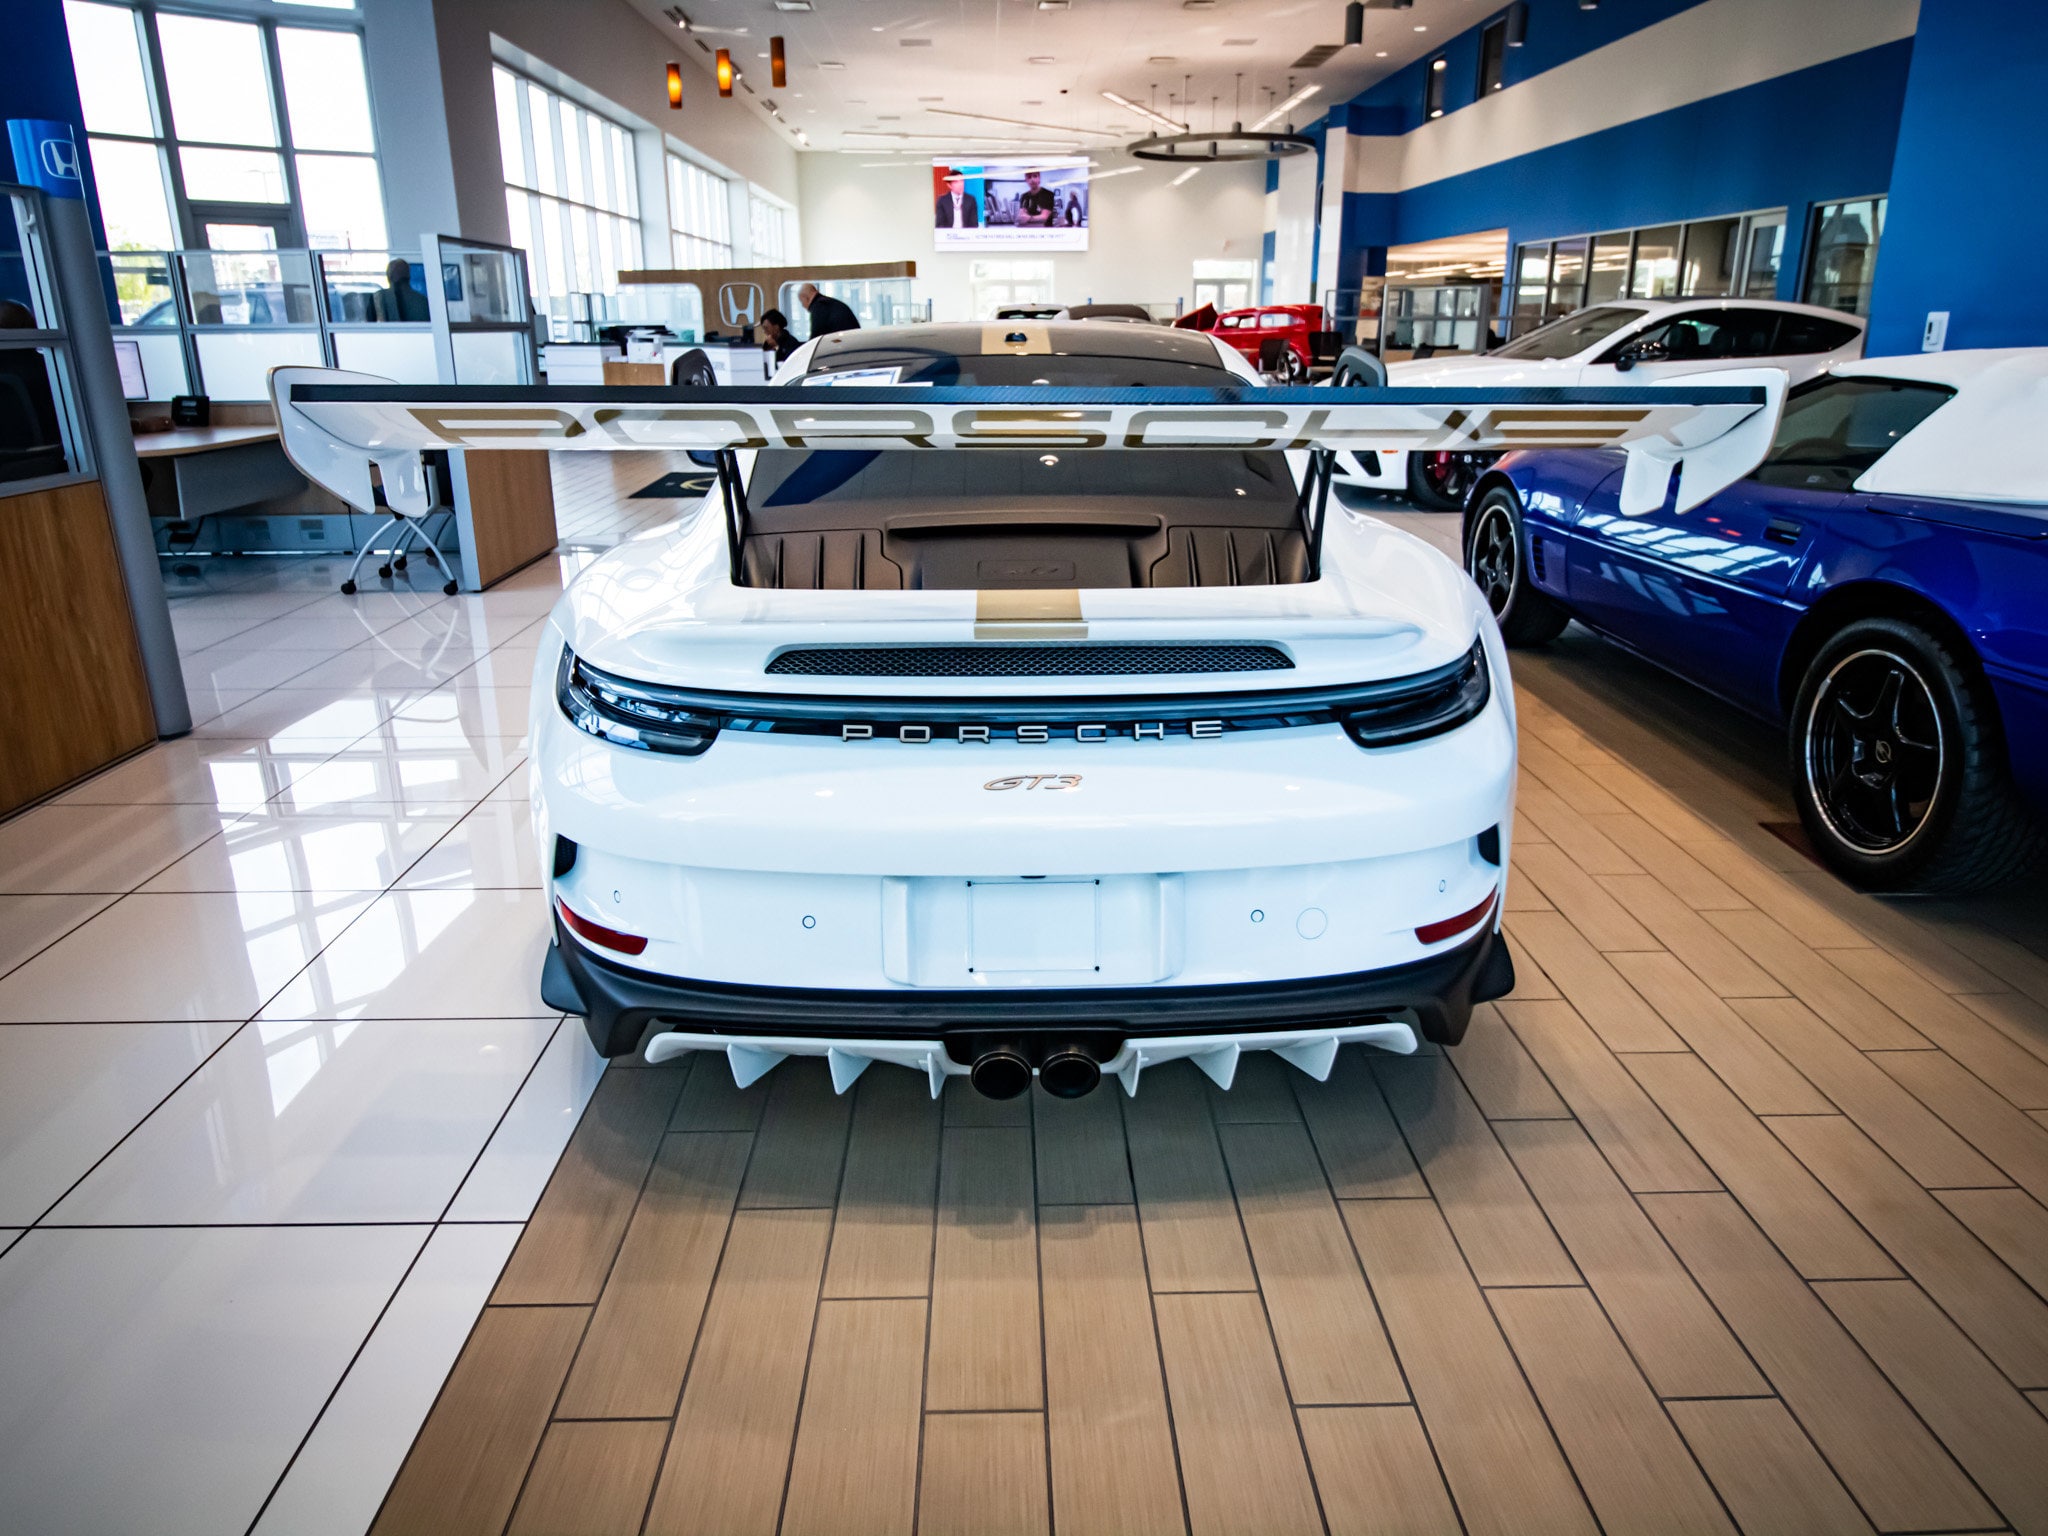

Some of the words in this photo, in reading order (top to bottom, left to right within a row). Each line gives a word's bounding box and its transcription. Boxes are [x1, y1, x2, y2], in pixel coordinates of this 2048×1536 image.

[407, 408, 1651, 449] PORSCHE
[841, 719, 1223, 743] PORSCHE
[983, 774, 1083, 791] GT3
